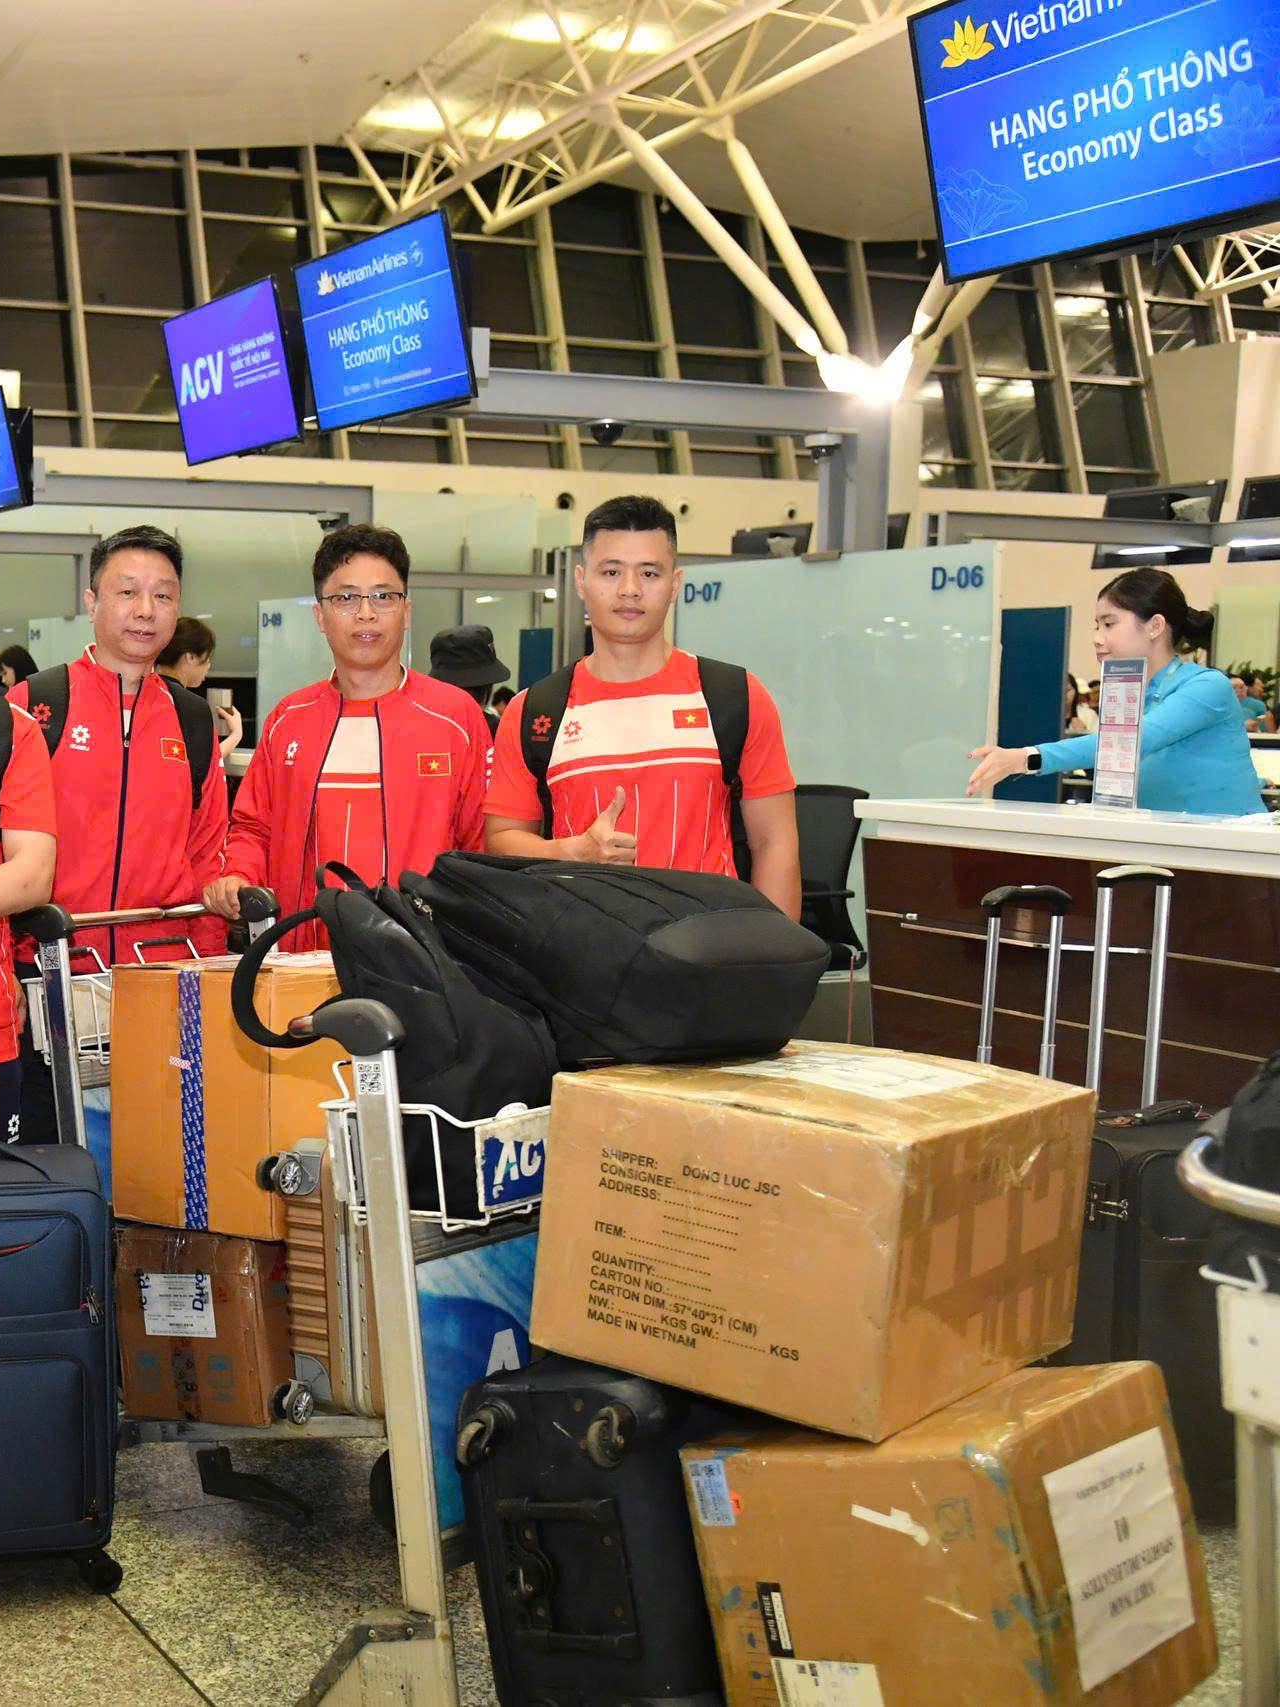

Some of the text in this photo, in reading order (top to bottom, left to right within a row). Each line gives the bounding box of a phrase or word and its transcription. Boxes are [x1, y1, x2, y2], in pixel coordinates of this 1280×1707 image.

[990, 39, 1254, 149] HẠNG PHỔ THÔNG
[1022, 103, 1224, 182] Economy Class
[328, 322, 361, 349] HẠNG
[385, 299, 429, 330] THÔNG
[342, 333, 422, 370] Economy Class
[180, 350, 224, 407] ACV
[683, 581, 722, 603] D-07
[930, 565, 984, 591] D-06
[493, 1138, 546, 1186] AC
[601, 1147, 781, 1197] SHIPPER: DONG LUC JSC
[595, 1220, 626, 1238] ITEM:
[590, 1265, 641, 1288] CARTON
[587, 1308, 697, 1349] MADE IN VIETNAM
[589, 1280, 640, 1303] CARTON
[728, 1317, 758, 1337] (CM)
[660, 1313, 687, 1331] KGS
[769, 1344, 800, 1361] KGS
